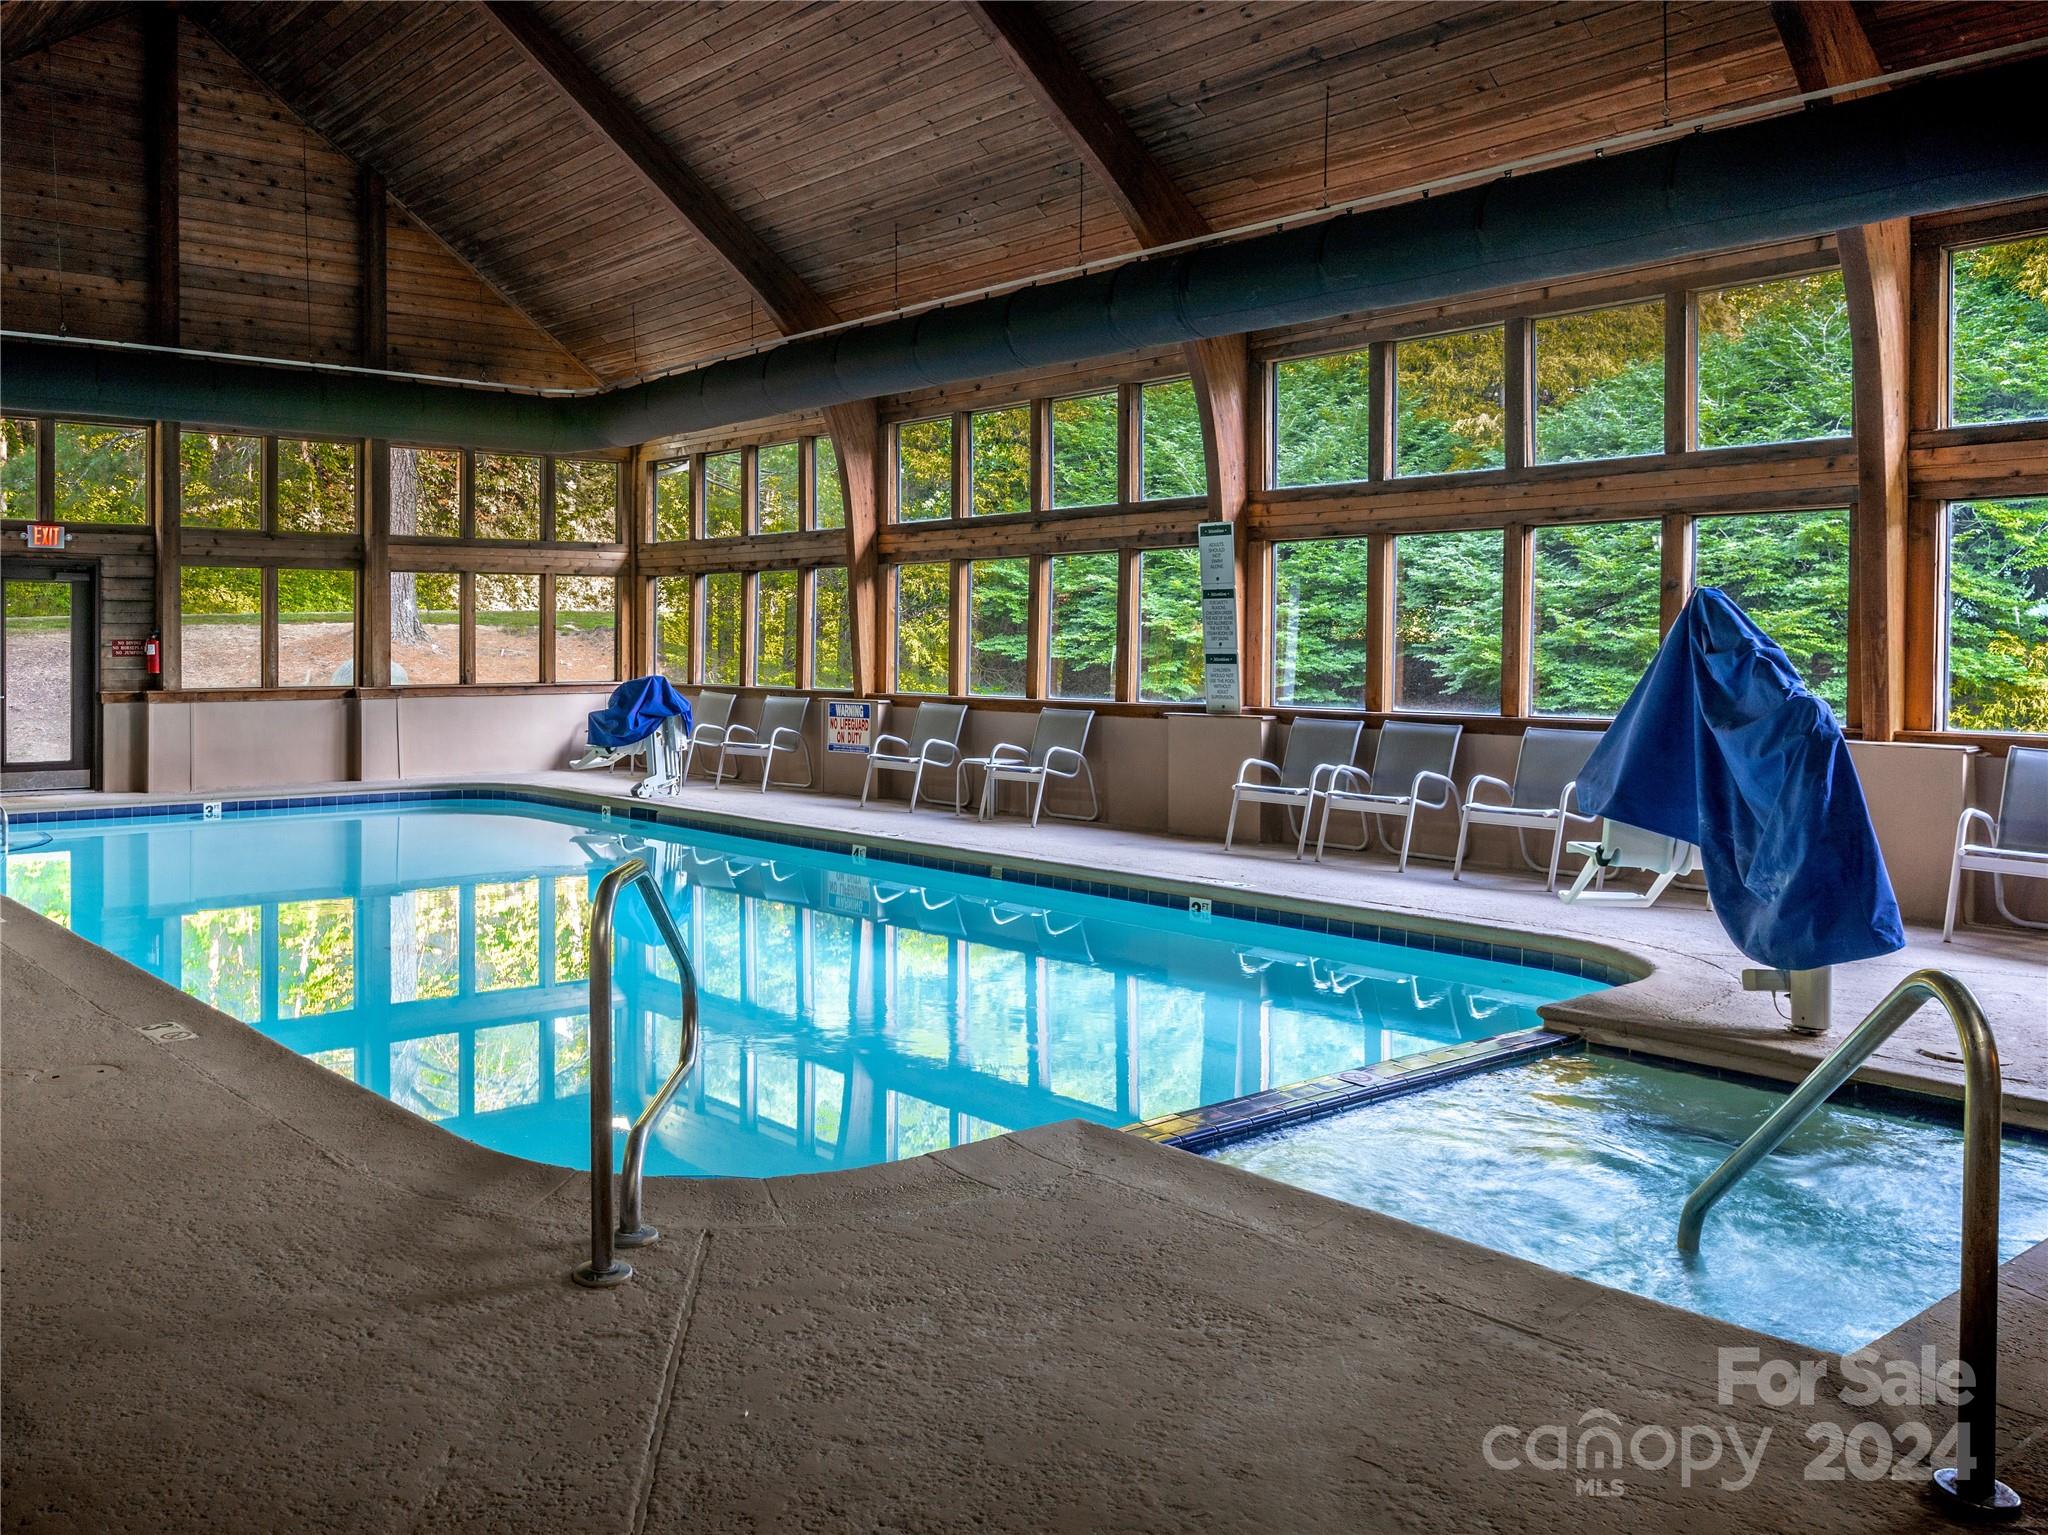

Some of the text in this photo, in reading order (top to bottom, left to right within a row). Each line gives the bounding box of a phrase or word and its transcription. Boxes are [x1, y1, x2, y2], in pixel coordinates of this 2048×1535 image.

[34, 526, 60, 546] EXIT
[835, 704, 864, 717] WARNING
[830, 718, 869, 731] NO LIFEGUARD
[837, 731, 862, 744] ON DUTY
